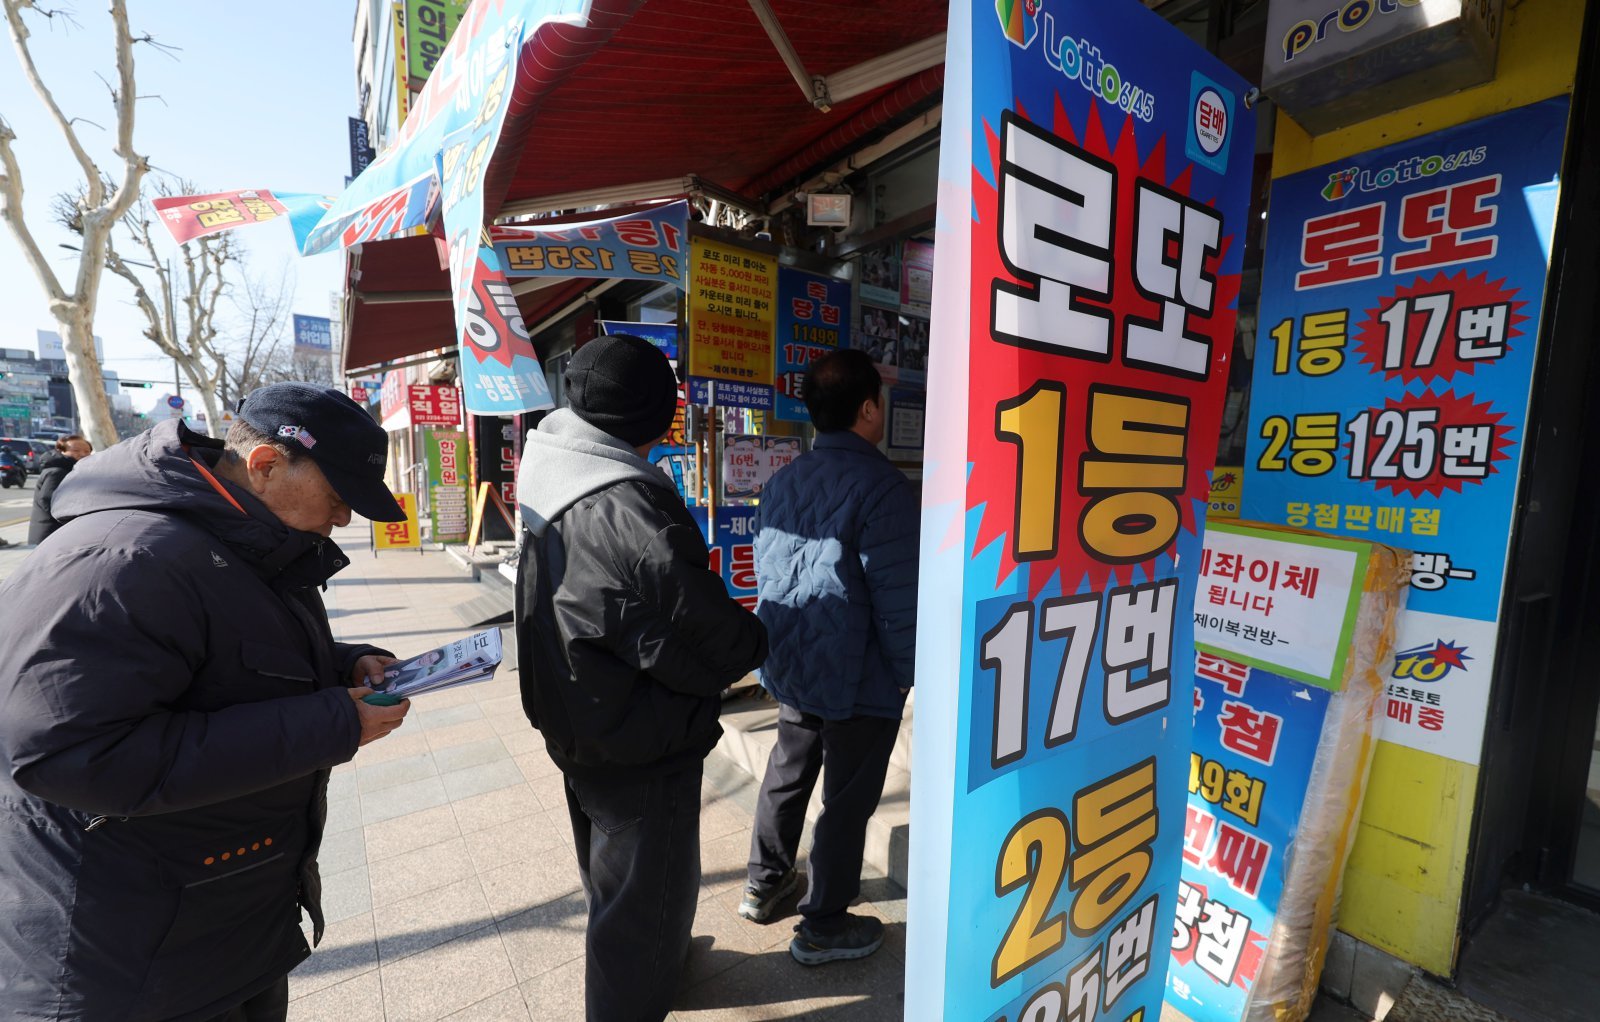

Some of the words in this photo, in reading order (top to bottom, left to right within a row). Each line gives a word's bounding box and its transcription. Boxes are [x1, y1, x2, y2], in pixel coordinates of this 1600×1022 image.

[416, 0, 446, 73] 의원
[1283, 0, 1424, 62] pro
[1200, 100, 1224, 136] 담배
[355, 121, 366, 152] MEGA
[991, 109, 1224, 382] 로또
[1295, 174, 1502, 291] 로또
[699, 262, 717, 274] 자동
[720, 267, 752, 281] 5,000원
[703, 249, 720, 261] 로또
[724, 254, 740, 266] 미리
[696, 275, 726, 289] 사실분은
[807, 281, 828, 303] 축
[699, 289, 733, 303] 카운터로
[736, 296, 751, 307] 미리
[707, 303, 732, 316] 오시면
[735, 308, 761, 322] 됩니다.
[792, 297, 840, 326] 당첨
[695, 333, 711, 345] 그냥
[792, 322, 839, 347] 1149회
[1269, 307, 1350, 377] 1등
[1378, 290, 1513, 371] 17번
[783, 342, 834, 366] 17번
[412, 386, 457, 401] 구인
[412, 400, 458, 415] 직업
[1256, 411, 1341, 477] 2등
[1345, 406, 1497, 482] 125번
[439, 440, 458, 486] 한의원
[994, 378, 1192, 566] 1등
[1208, 501, 1236, 512] oto
[1286, 502, 1441, 536] 당첨판매점
[1208, 585, 1274, 616] 됩니다
[981, 577, 1179, 770] 17번
[990, 755, 1159, 989] 2등
